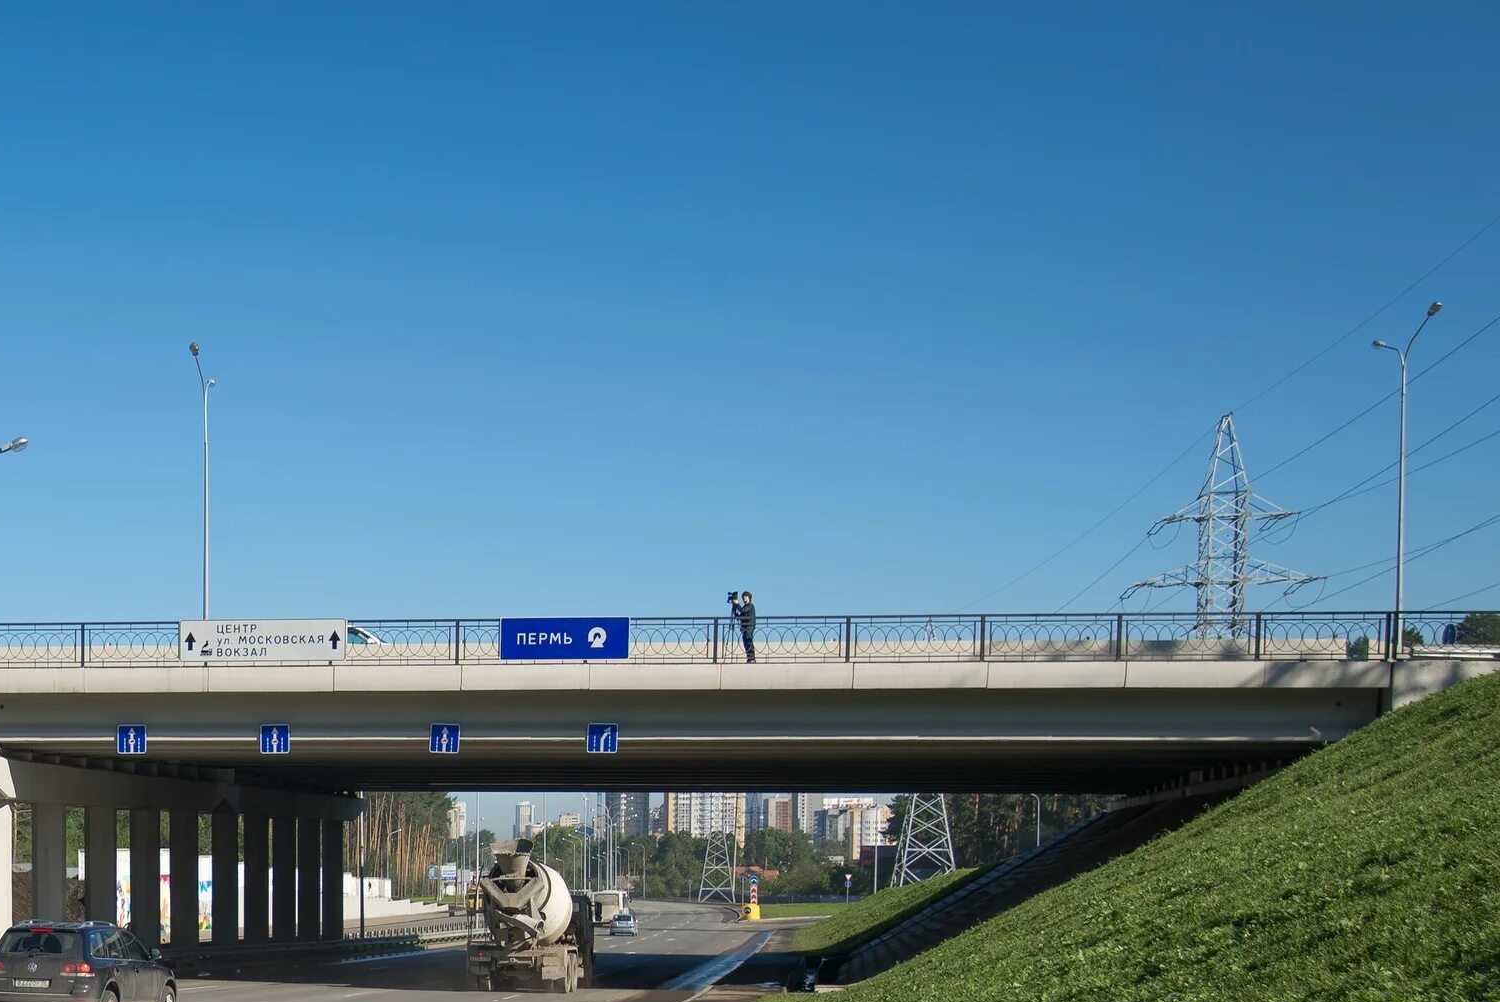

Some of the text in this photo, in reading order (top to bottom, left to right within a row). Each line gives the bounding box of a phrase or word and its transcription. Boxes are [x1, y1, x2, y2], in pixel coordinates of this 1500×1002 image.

[216, 624, 258, 635] ЦЕНТР
[217, 635, 325, 647] ул. МОСКОВСКАЯ
[516, 632, 573, 645] ПЕРМЬ
[216, 647, 268, 657] ВОКЗАЛ
